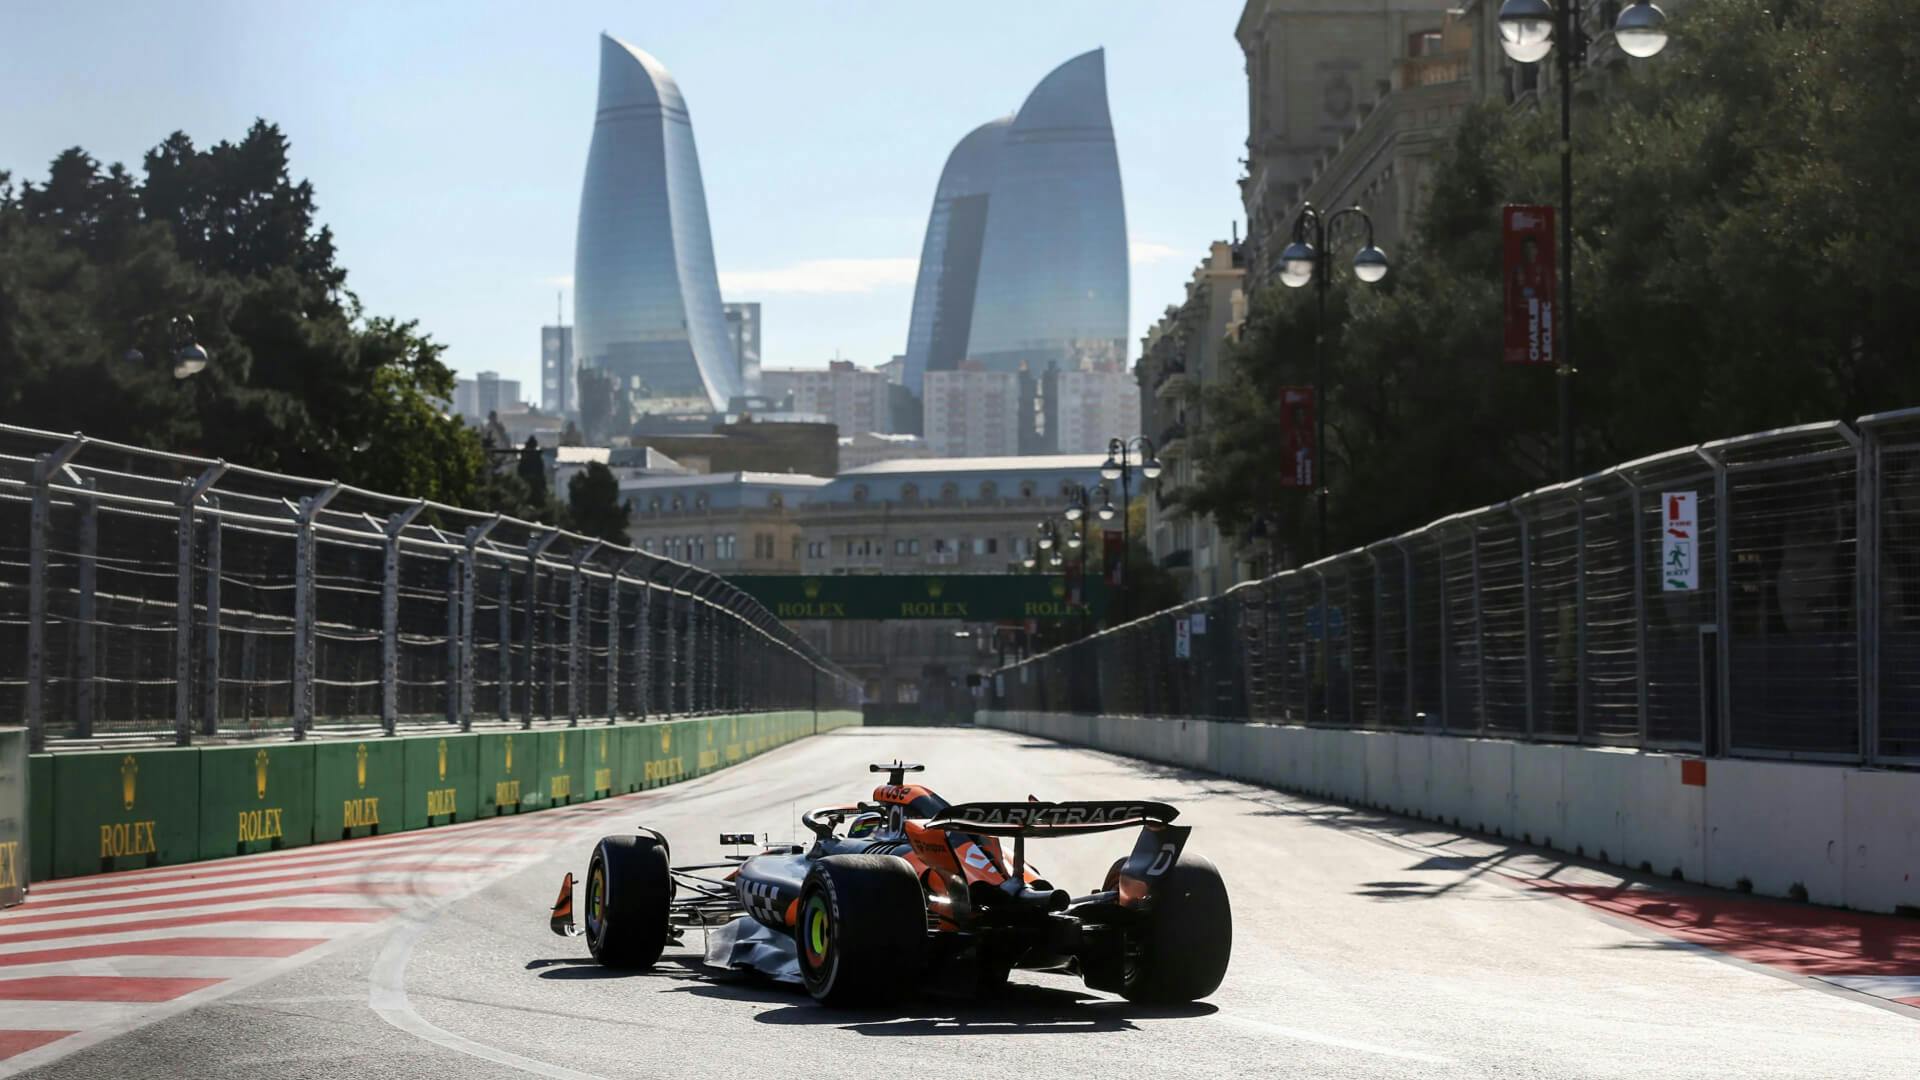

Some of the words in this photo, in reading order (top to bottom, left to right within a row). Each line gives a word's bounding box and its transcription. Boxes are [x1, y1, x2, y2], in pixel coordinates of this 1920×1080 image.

[778, 602, 845, 617] ROLEX
[901, 602, 968, 617] ROLEX
[343, 797, 380, 828] ROLEX
[427, 788, 457, 816] ROLEX
[963, 806, 1145, 826] DARKTRACE
[101, 820, 156, 858] ROLEX
[239, 808, 282, 843] ROLEX
